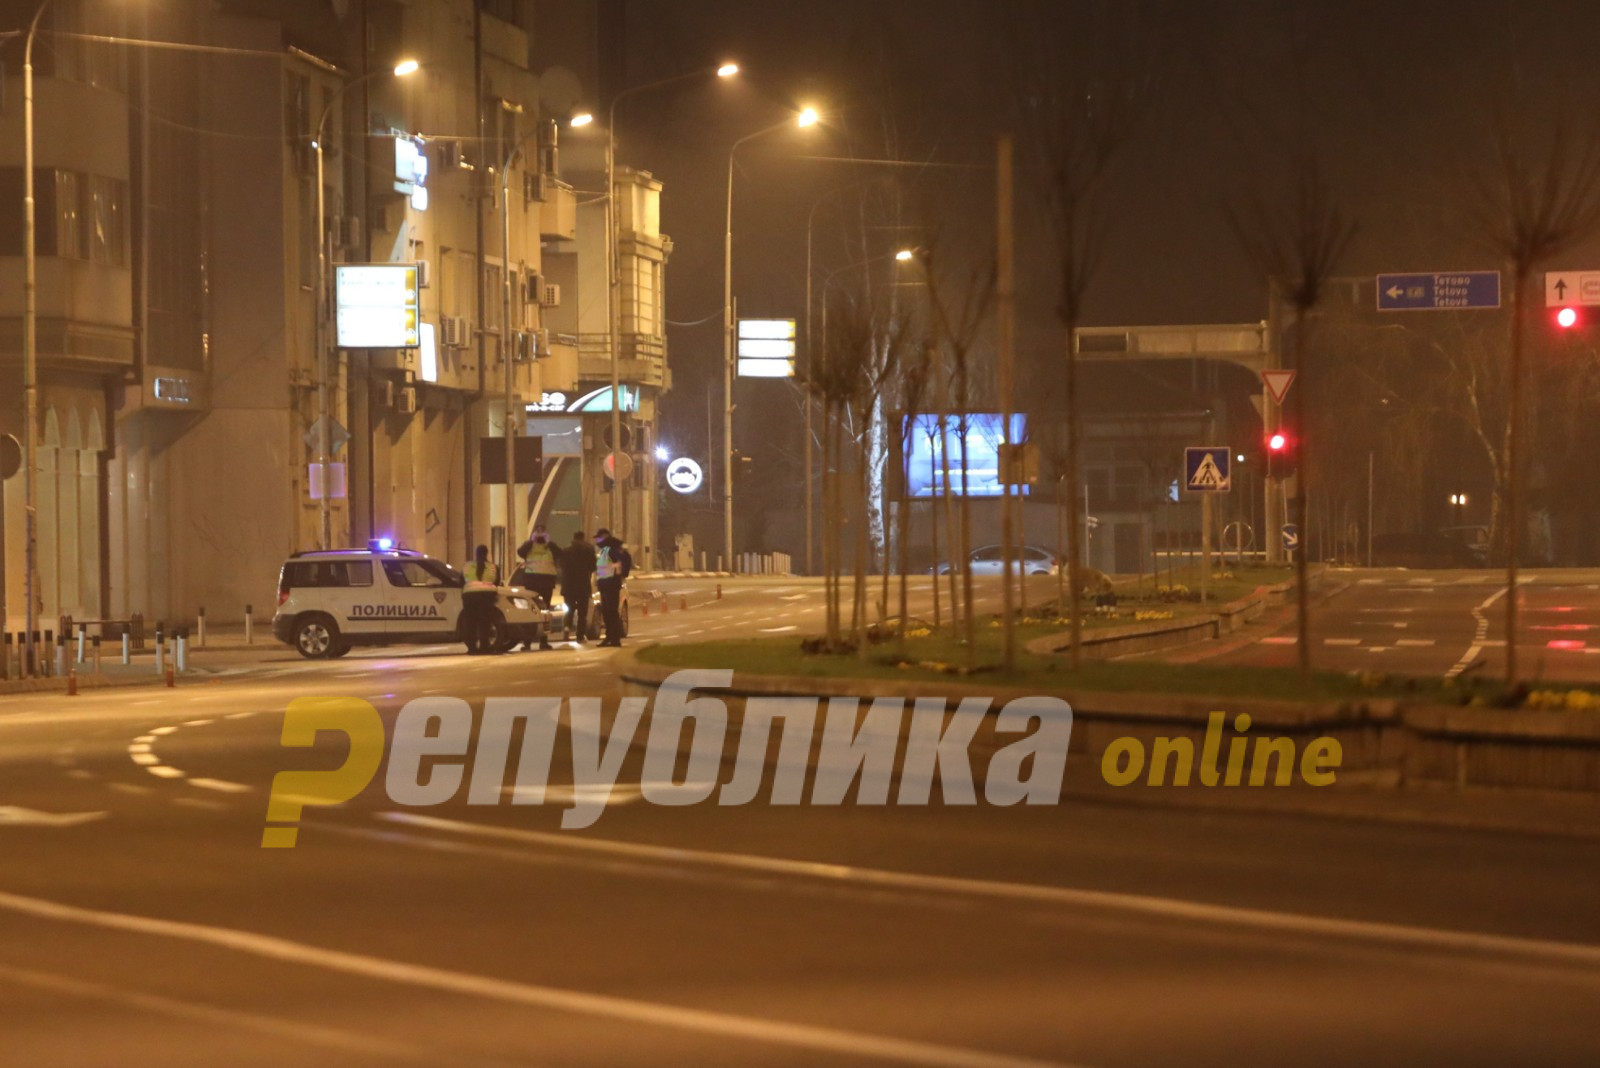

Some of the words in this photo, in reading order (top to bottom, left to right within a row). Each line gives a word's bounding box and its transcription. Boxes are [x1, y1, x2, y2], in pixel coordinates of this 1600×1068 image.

[1433, 275, 1471, 285] Тетово
[1433, 286, 1468, 296] Tetovo
[352, 605, 437, 617] ПОЛИЦИЈА
